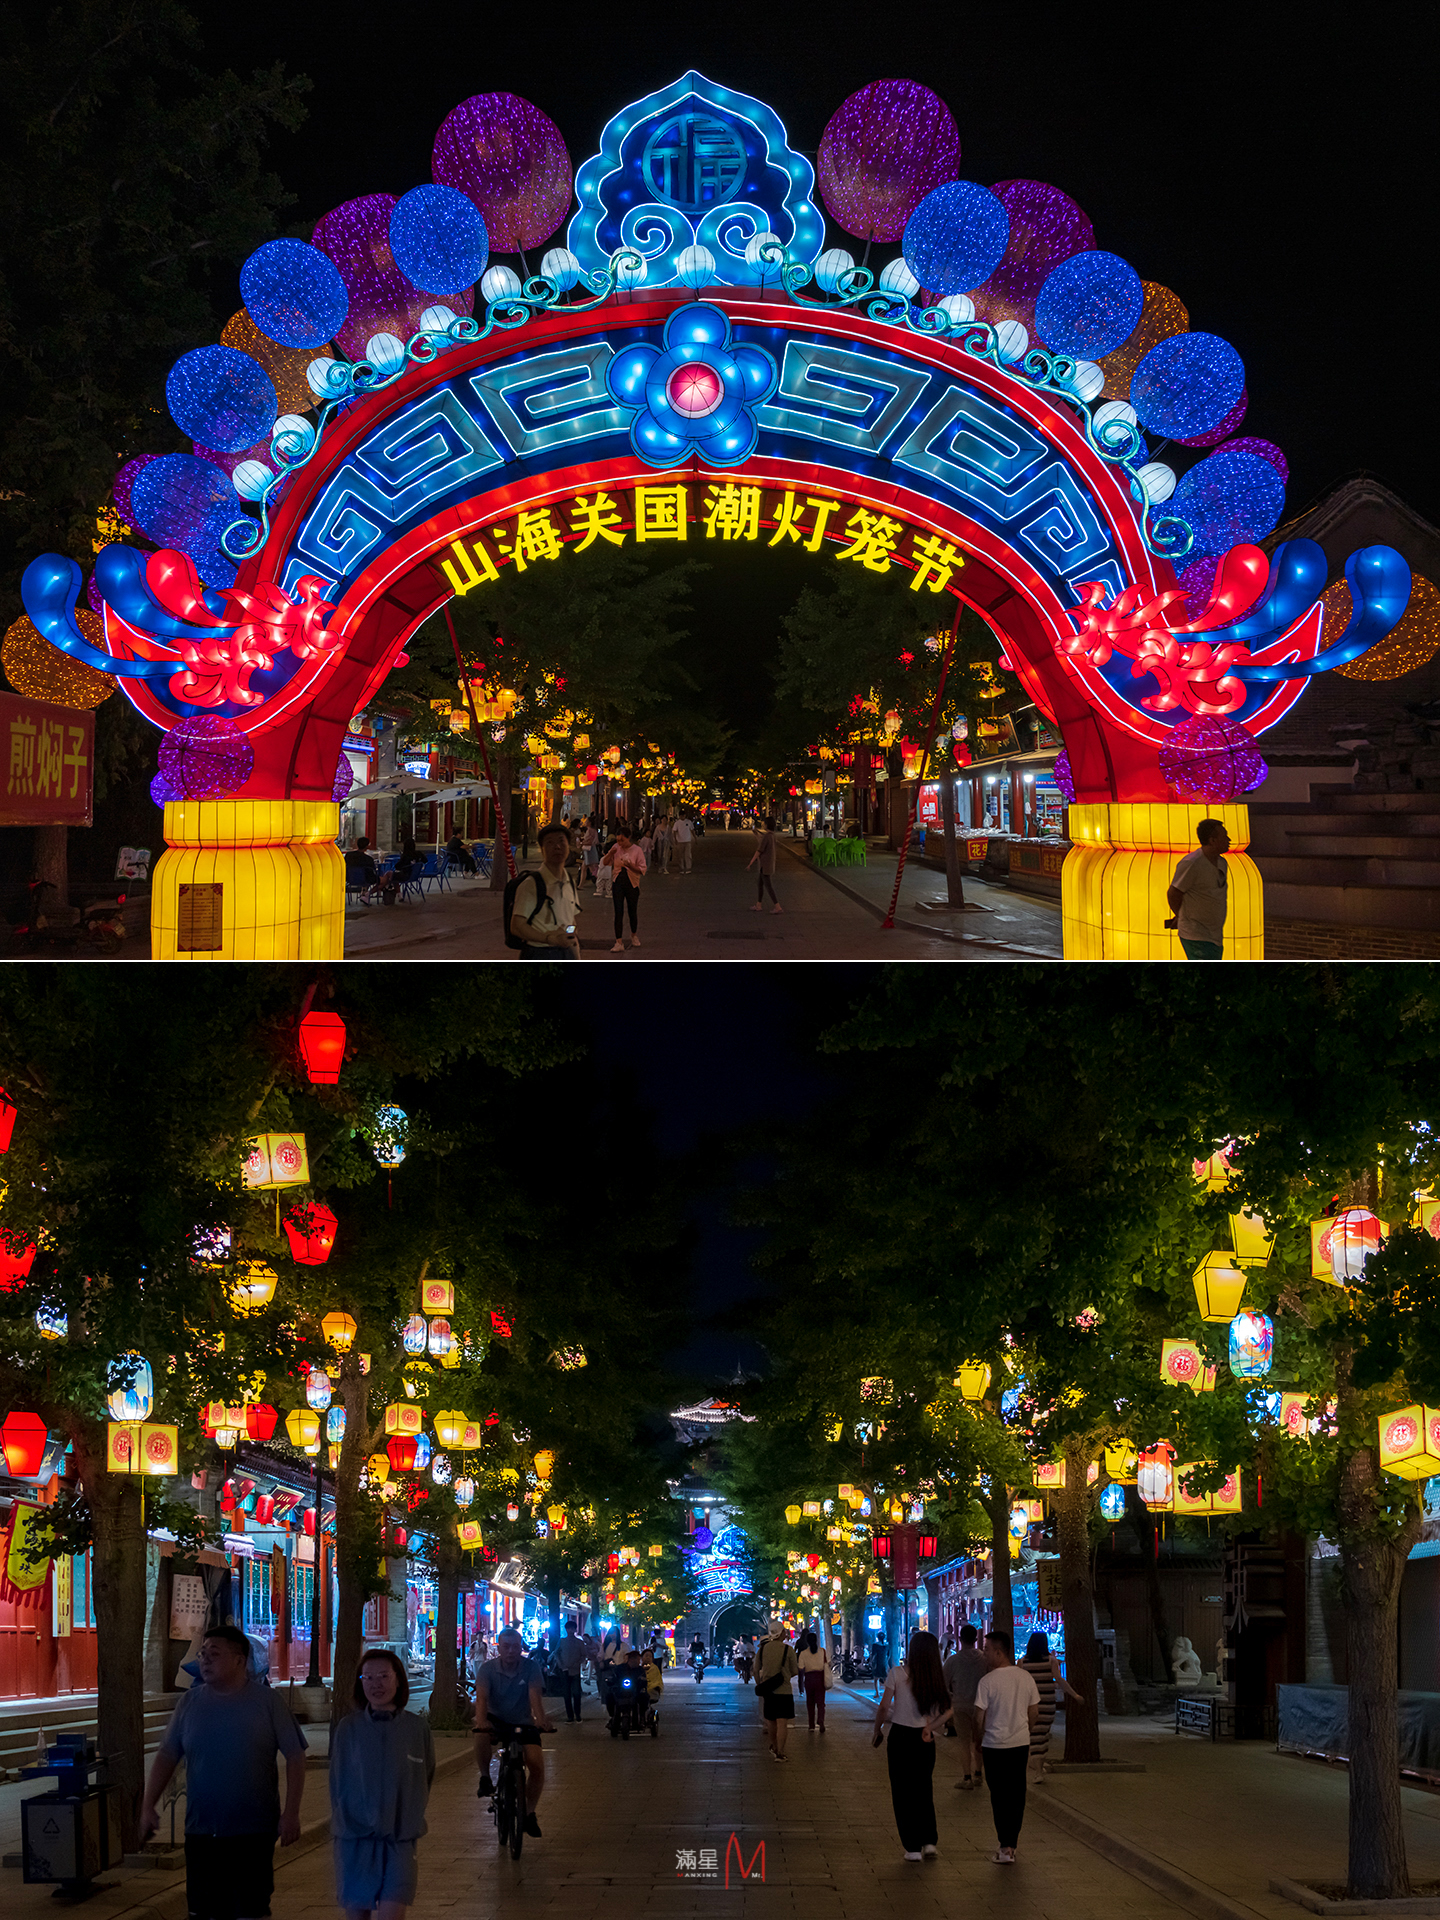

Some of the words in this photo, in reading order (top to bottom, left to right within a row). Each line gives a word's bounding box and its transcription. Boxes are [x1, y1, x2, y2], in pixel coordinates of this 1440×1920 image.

[441, 484, 965, 596] 山海关国潮灯笼节
[7, 714, 88, 799] 煎焖子
